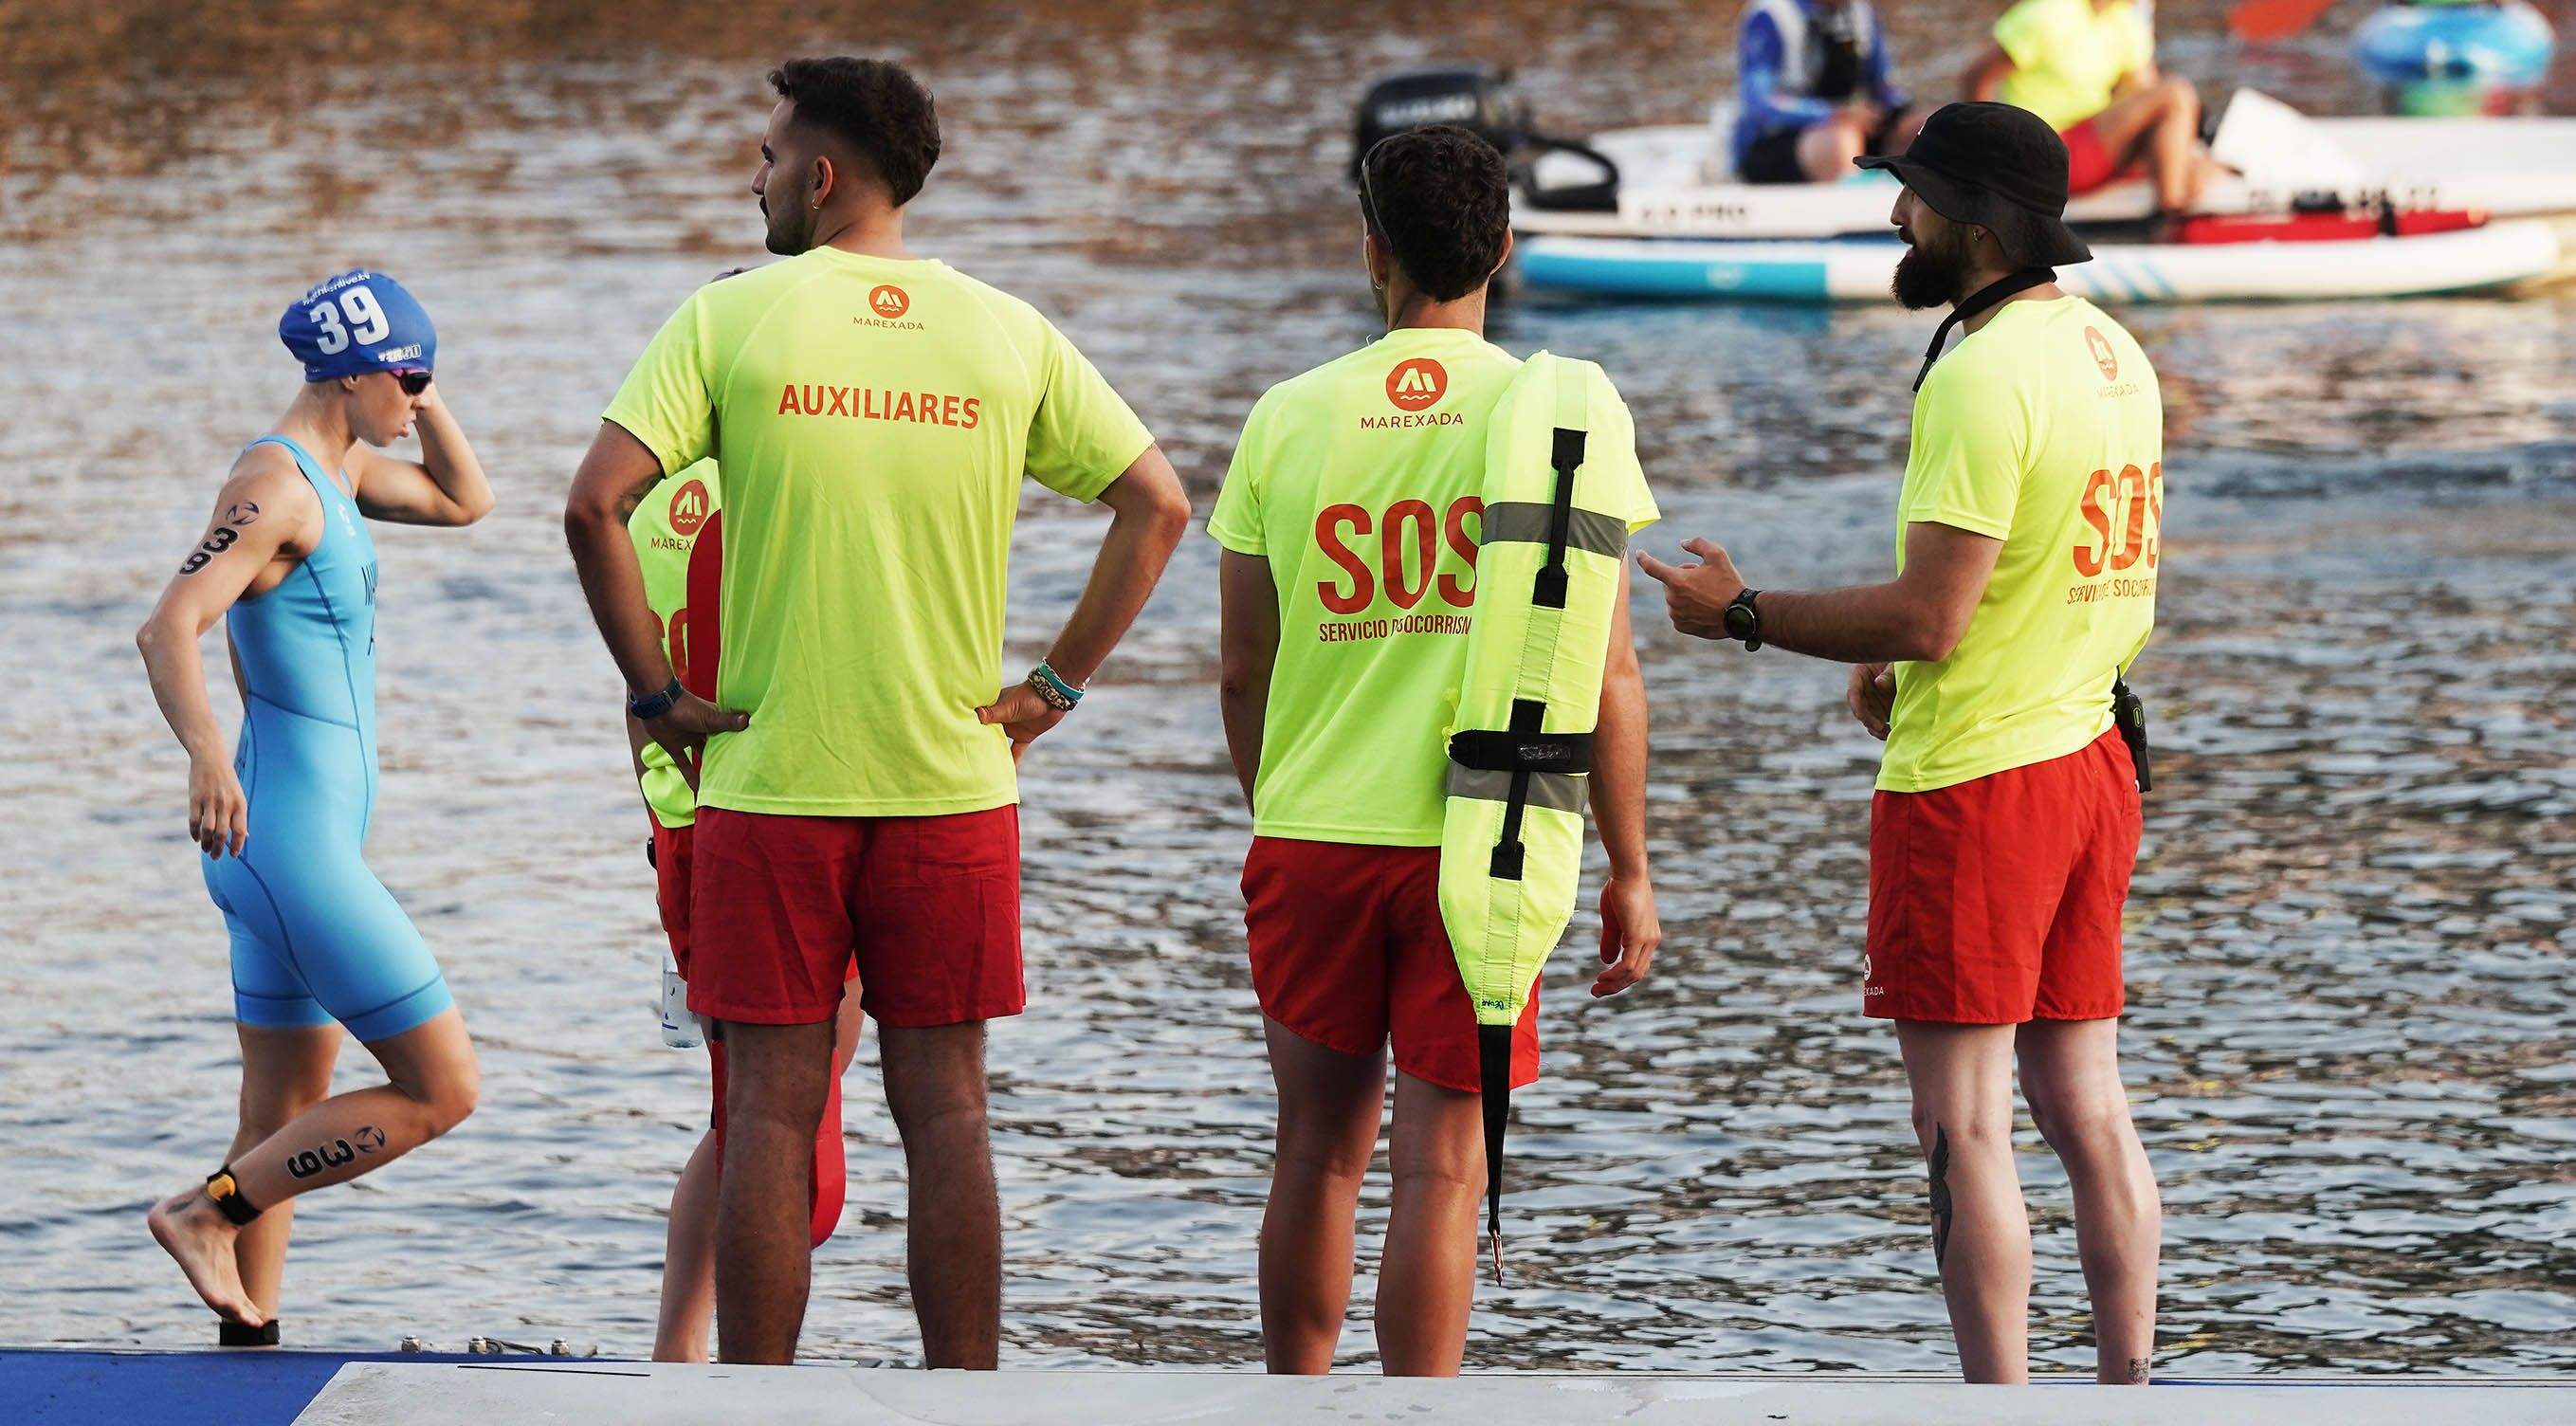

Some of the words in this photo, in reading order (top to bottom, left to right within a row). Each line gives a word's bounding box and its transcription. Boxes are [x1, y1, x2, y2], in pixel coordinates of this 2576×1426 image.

[309, 284, 390, 355] 39
[853, 317, 924, 331] MAREXADA
[777, 384, 980, 430] AUXILIARES
[1361, 413, 1464, 429] MAREXADA
[179, 527, 239, 576] 39
[650, 537, 693, 551] MAREX
[1315, 496, 1485, 615] SOS
[1319, 619, 1388, 643] SERVICIO
[287, 1139, 356, 1179] 39
